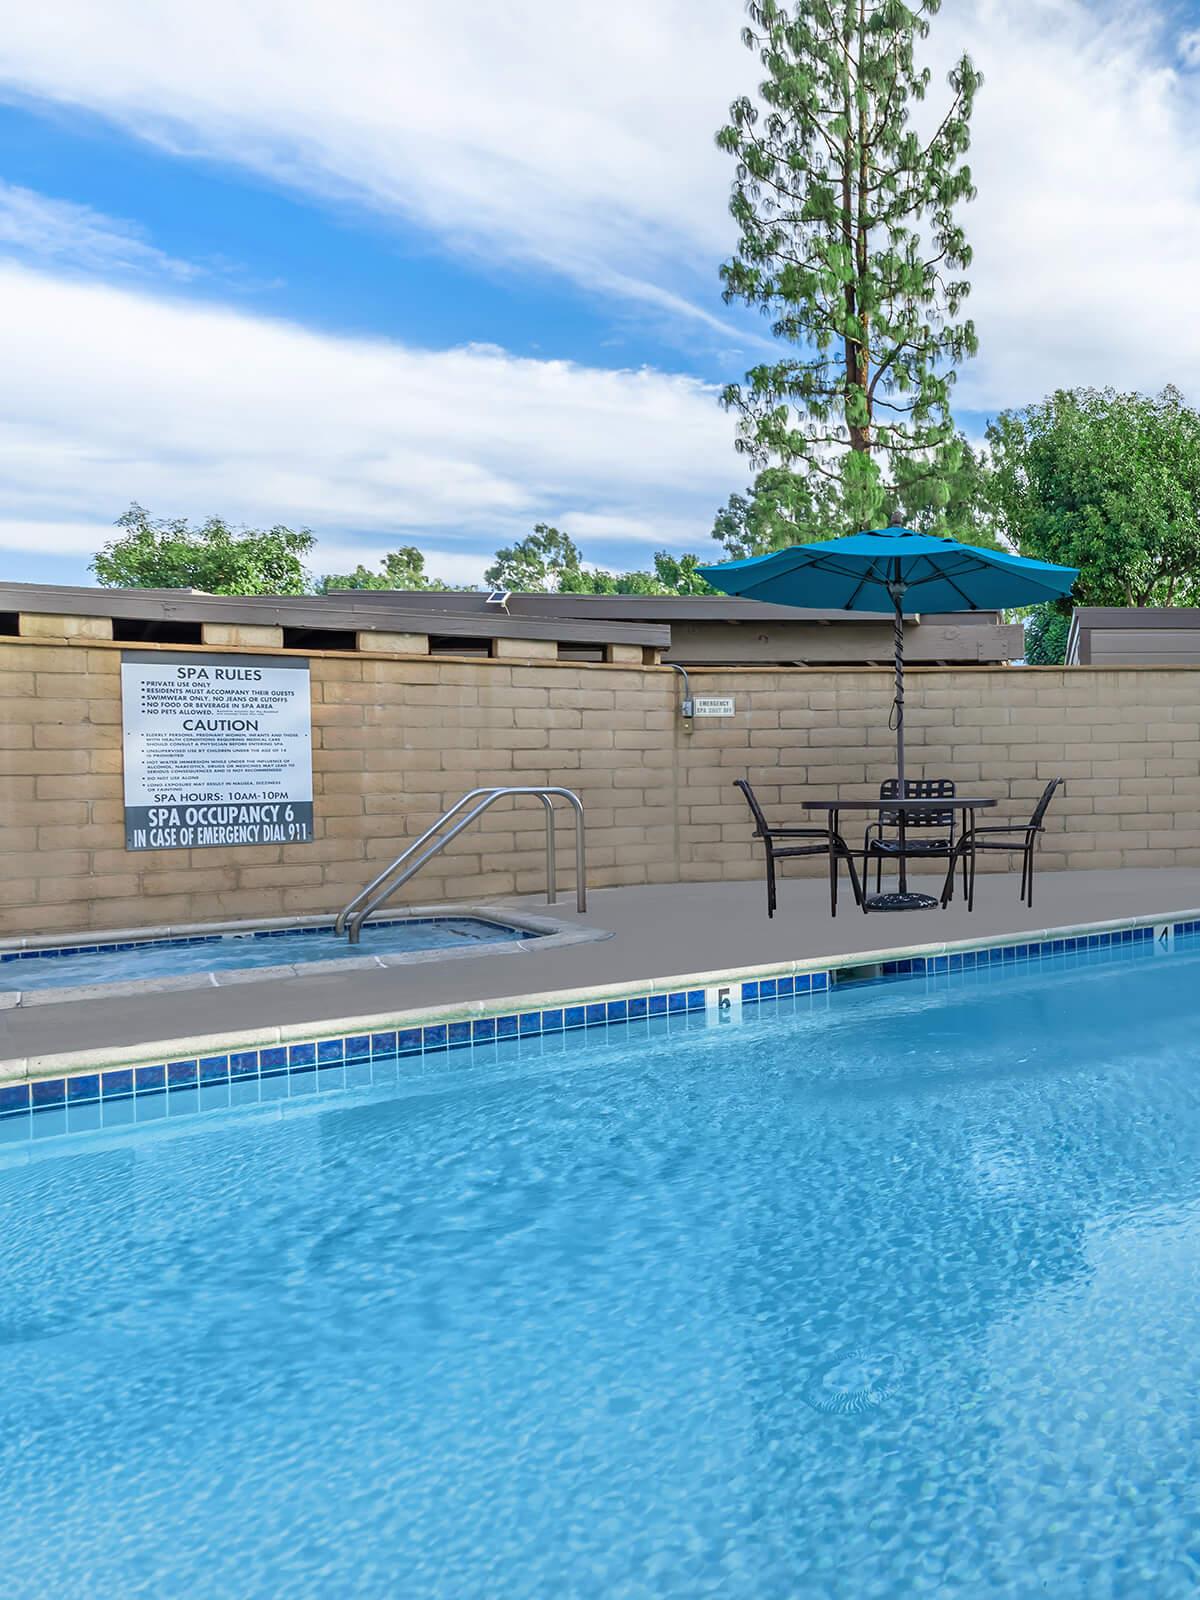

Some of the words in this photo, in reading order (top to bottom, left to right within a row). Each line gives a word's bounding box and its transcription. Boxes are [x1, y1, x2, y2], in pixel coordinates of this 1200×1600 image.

[177, 668, 209, 679] SPA
[215, 669, 262, 680] RULES
[183, 719, 258, 731] CAUTION
[154, 794, 177, 803] SPA
[180, 792, 224, 802] HOURS:
[228, 791, 289, 801] 10AM-10PM
[148, 808, 180, 827] SPA
[185, 805, 280, 826] OCCUPANCY
[285, 805, 294, 822] 6
[134, 829, 146, 847] IN
[150, 828, 177, 846] CASE
[180, 828, 194, 845] OF
[198, 824, 259, 844] EMERGENCY
[263, 824, 286, 841] DIAL
[288, 823, 307, 840] 911
[718, 987, 731, 1009] 5
